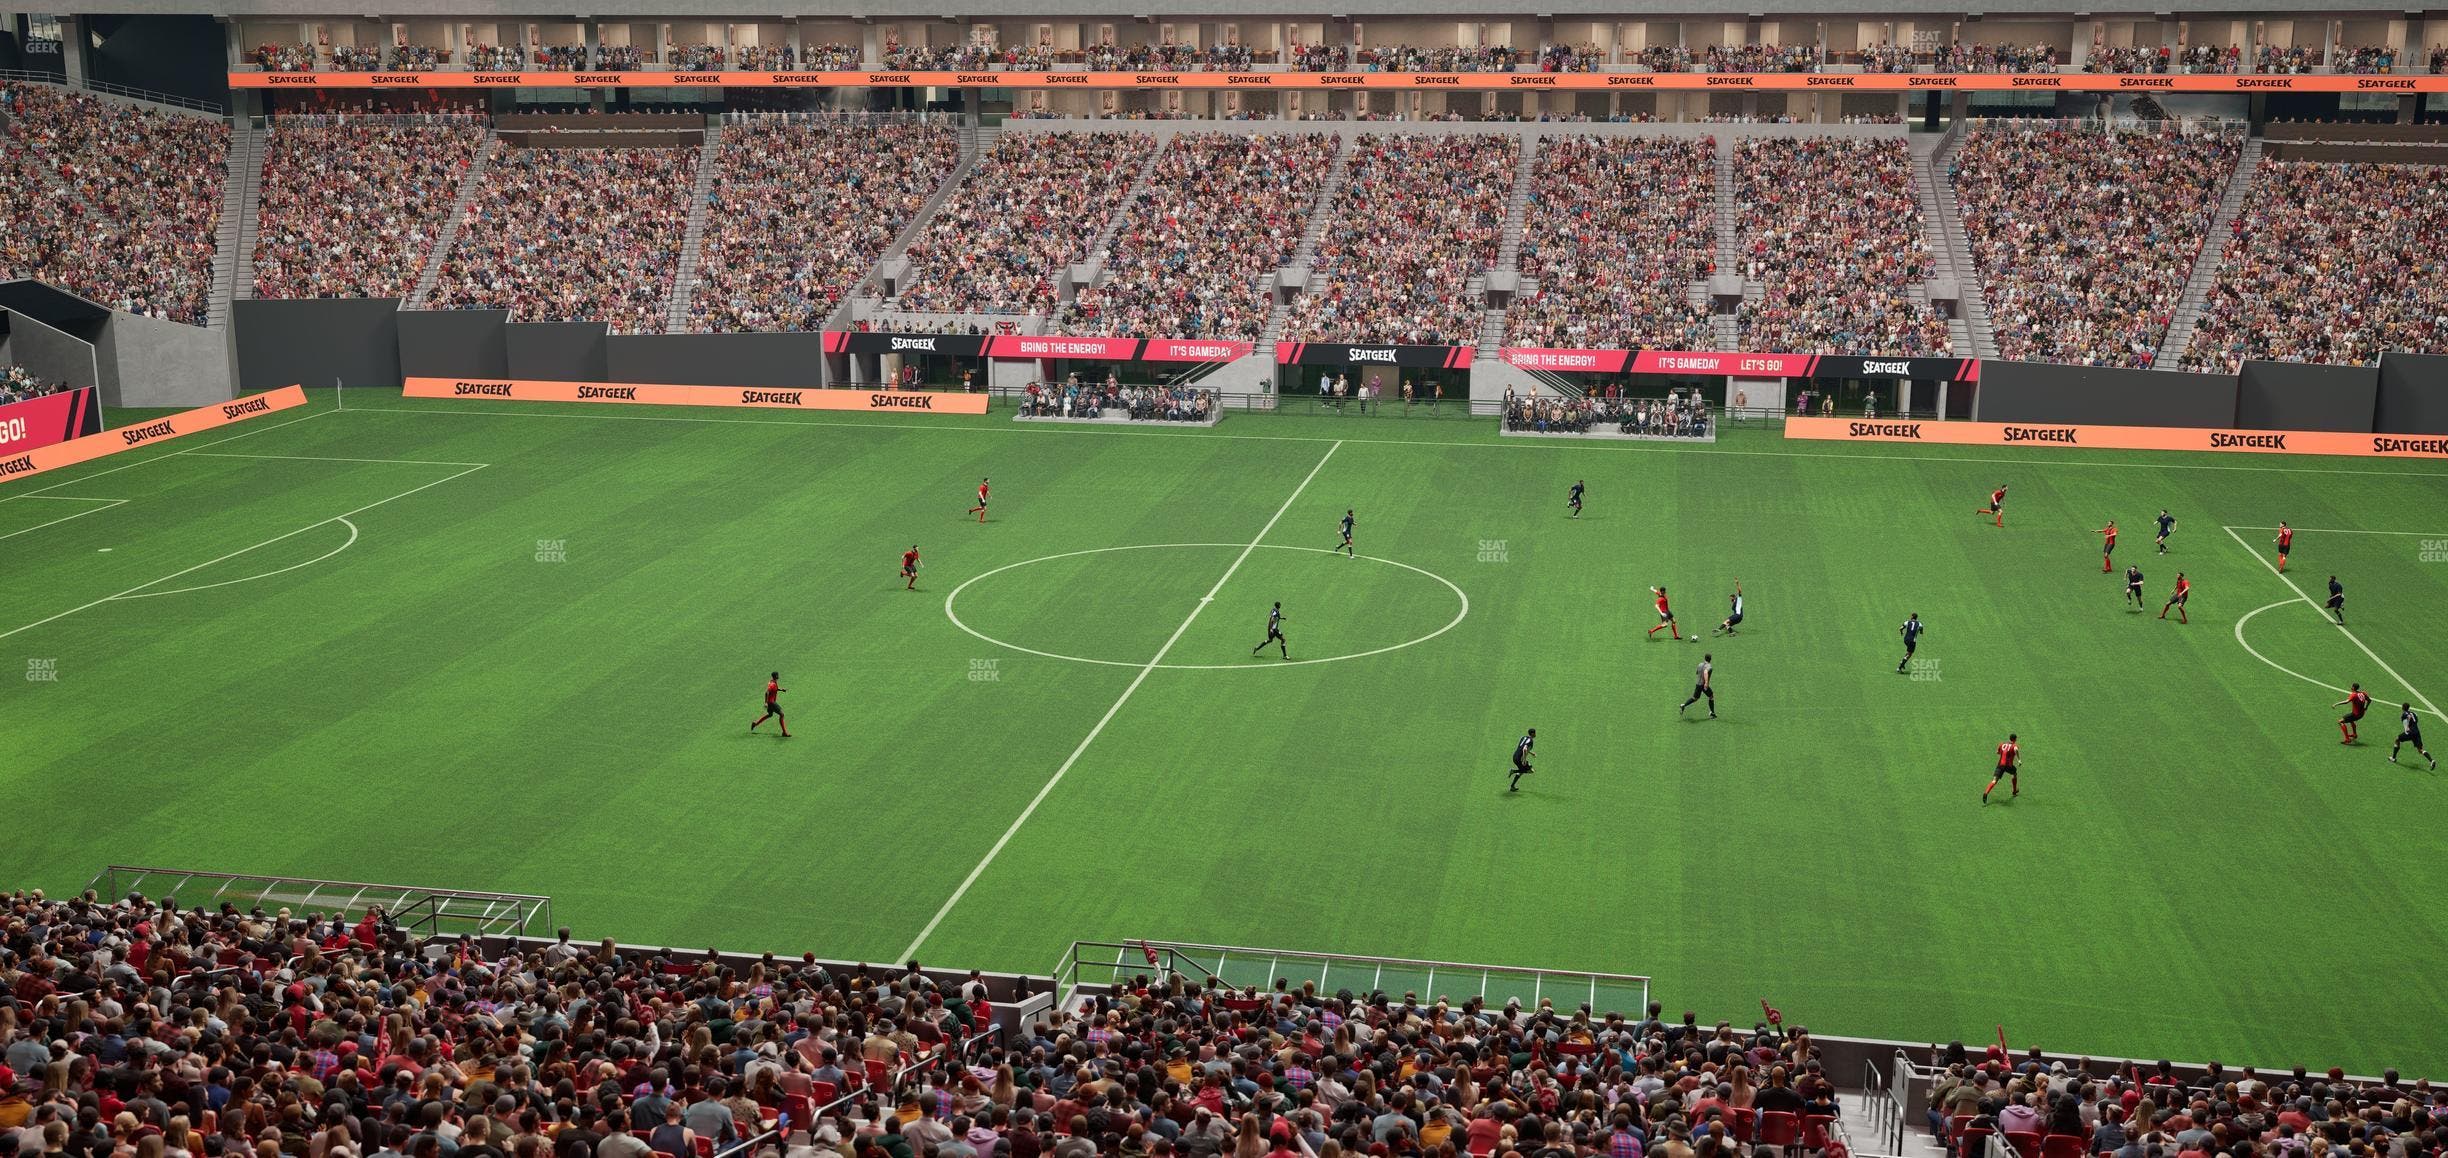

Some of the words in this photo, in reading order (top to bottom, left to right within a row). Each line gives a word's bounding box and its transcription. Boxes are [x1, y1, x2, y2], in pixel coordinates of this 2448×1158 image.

[268, 75, 317, 84] SEATGEEK
[371, 75, 419, 84] SEATGEEK
[473, 75, 521, 84] SEATGEEK
[574, 75, 621, 84] SEATGEEK
[674, 75, 721, 83] SEATGEEK
[773, 75, 819, 83] SEATGEEK
[869, 75, 911, 83] SEATGEEK
[957, 75, 999, 83] SEATGEEK
[1046, 75, 1088, 84] SEATGEEK
[1136, 75, 1179, 84] SEATGEEK
[1227, 76, 1271, 84] SEATGEEK
[1320, 76, 1364, 84] SEATGEEK
[1415, 76, 1460, 85] SEATGEEK
[1510, 76, 1556, 85] SEATGEEK
[1607, 76, 1653, 85] SEATGEEK
[1706, 77, 1753, 85] SEATGEEK
[1807, 77, 1854, 86] SEATGEEK
[1908, 77, 1957, 86] SEATGEEK
[2012, 78, 2061, 87] SEATGEEK
[2120, 78, 2174, 87] SEATGEEK
[2236, 79, 2292, 88] SEATGEEK
[2358, 79, 2416, 89] SEATGEEK
[891, 337, 936, 351] SEATGEEK
[1021, 342, 1048, 353] BRING
[1050, 343, 1066, 353] THE
[1069, 343, 1106, 355] ENERGY!
[1170, 346, 1187, 356] IT'S
[1190, 346, 1231, 358] GAMEDAY
[1349, 348, 1397, 362] SEATGEEK
[1512, 354, 1538, 365] BRING
[1541, 355, 1557, 365] THE
[1559, 355, 1596, 366] ENERGY!
[1659, 358, 1676, 368] IT'S
[1677, 358, 1720, 370] GAMEDAY
[1741, 360, 1765, 370] LET'S
[1767, 360, 1783, 371] GO!
[1863, 361, 1910, 375] SEATGEEK
[454, 382, 513, 397] SEATGEEK
[577, 385, 636, 400] SEATGEEK
[742, 391, 801, 405] SEATGEEK
[871, 394, 932, 409] SEATGEEK
[222, 396, 270, 420] SEATGEEK
[122, 420, 176, 445] SEATGEEK
[1850, 422, 1921, 439] SEATGEEK
[2004, 427, 2077, 443] SEATGEEK
[2211, 432, 2286, 449] SEATGEEK
[2374, 438, 2448, 454] SEATGEEK
